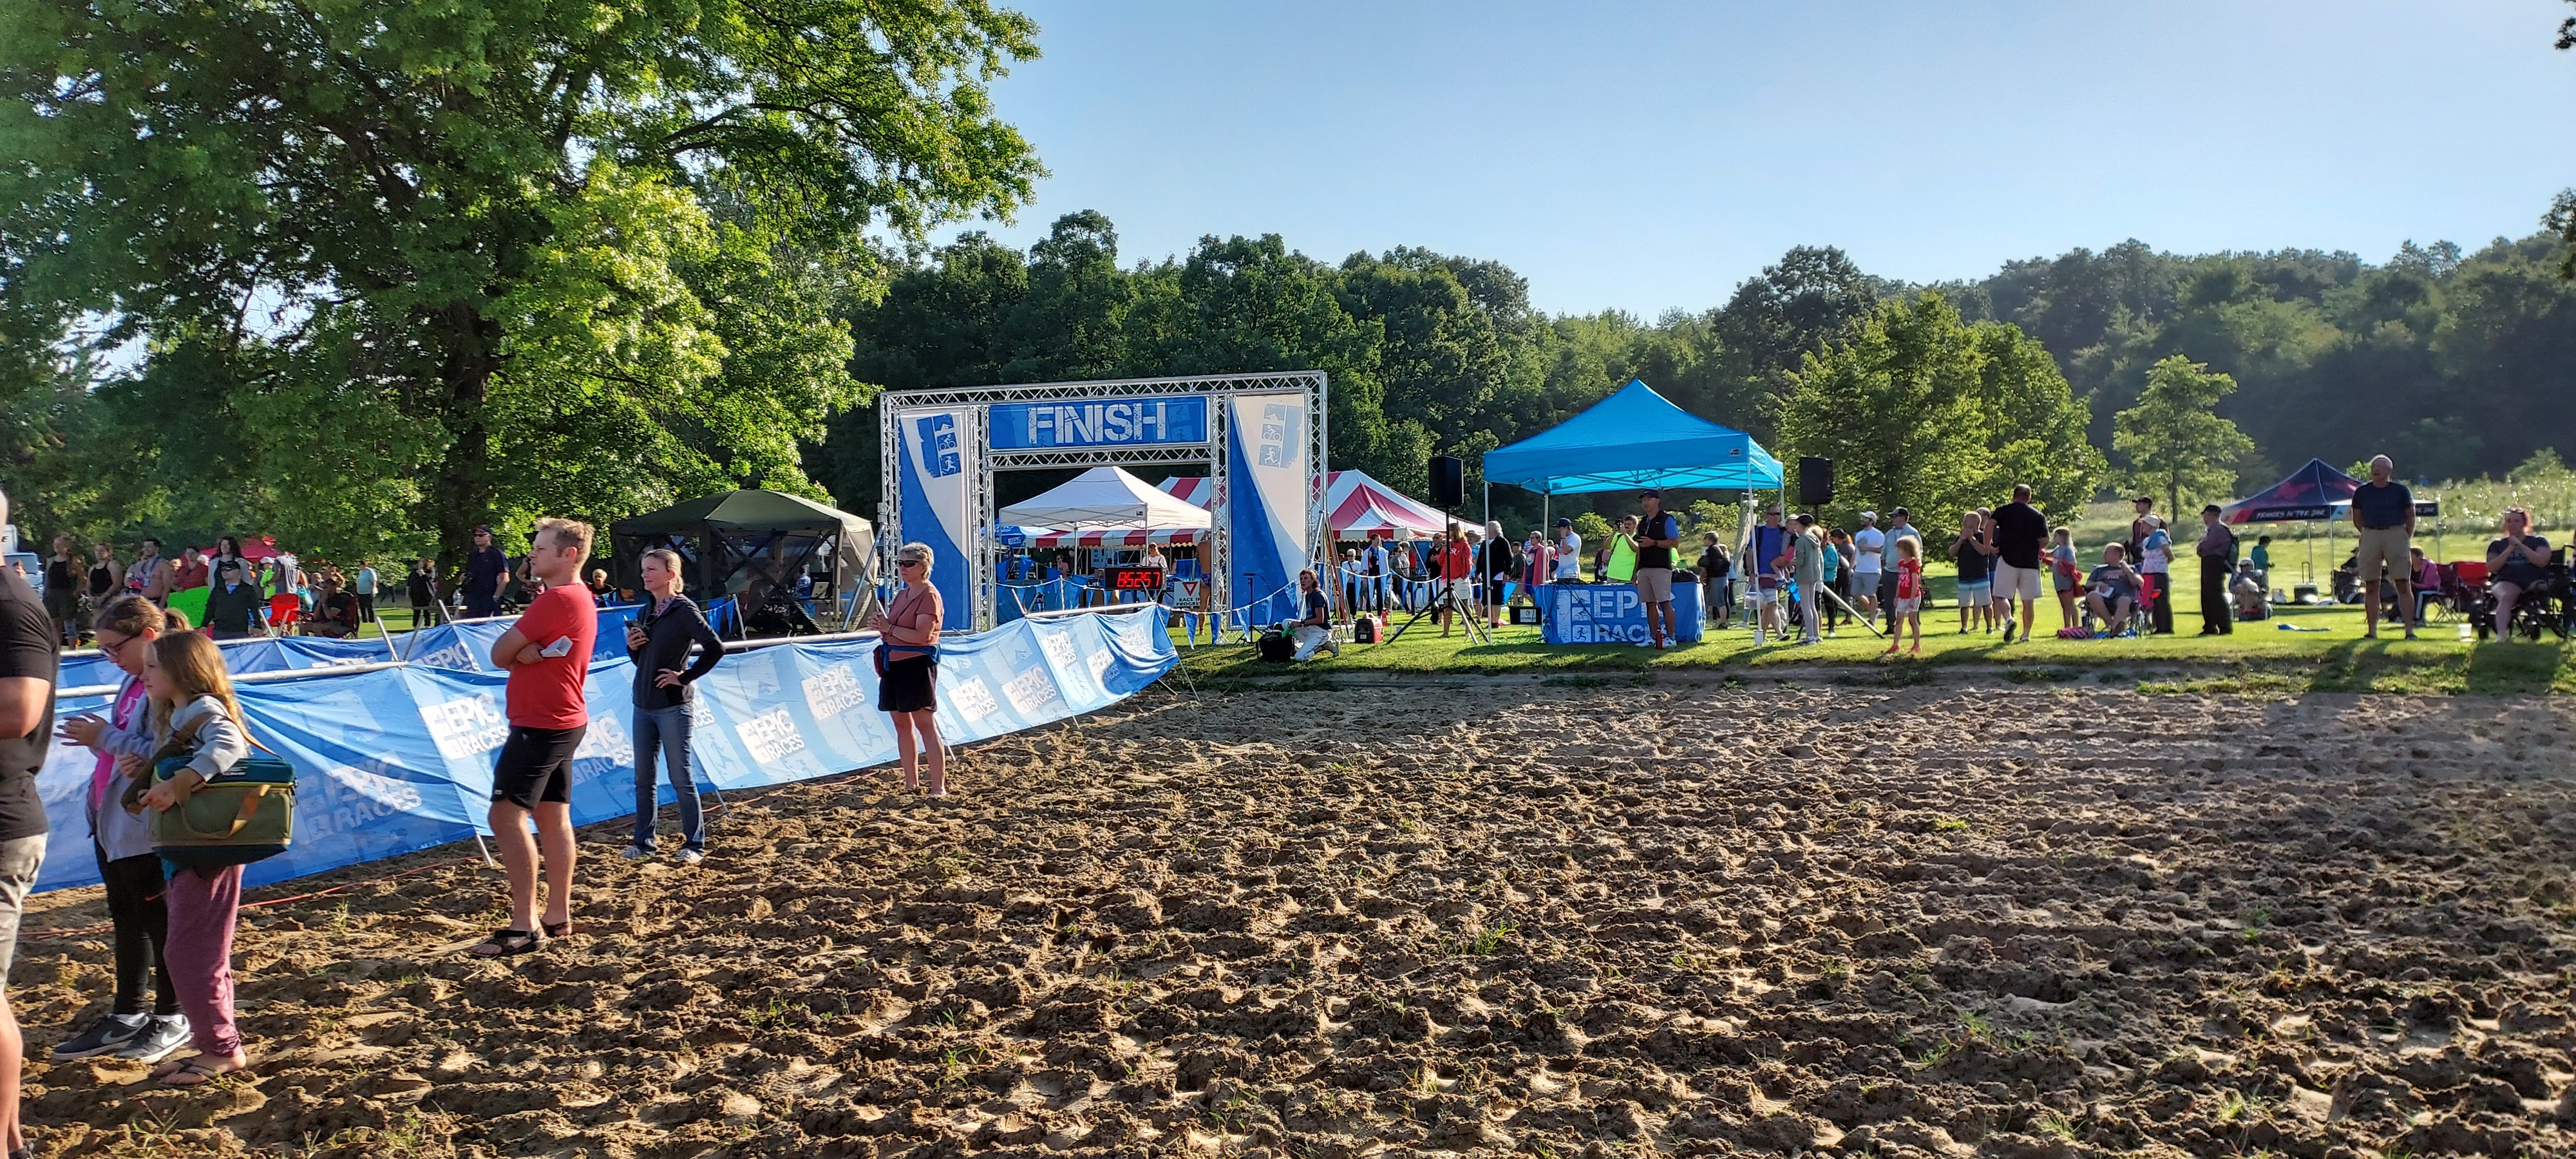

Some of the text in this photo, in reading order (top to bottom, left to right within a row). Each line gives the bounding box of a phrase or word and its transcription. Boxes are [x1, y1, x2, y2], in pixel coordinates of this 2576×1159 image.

[1028, 402, 1166, 444] FINISH
[818, 664, 856, 697] EPIC
[959, 679, 989, 704] EPIC
[1014, 666, 1048, 697] EPIC
[827, 688, 865, 714] RACES
[971, 699, 998, 720] RACES
[1027, 684, 1057, 710] RACES
[443, 693, 500, 735] EPIC
[693, 708, 715, 728] CES
[750, 710, 794, 742] EPIC
[459, 725, 511, 757] RACES
[764, 734, 805, 760] RACES
[578, 744, 634, 780] RACES
[334, 787, 422, 832] RACES
